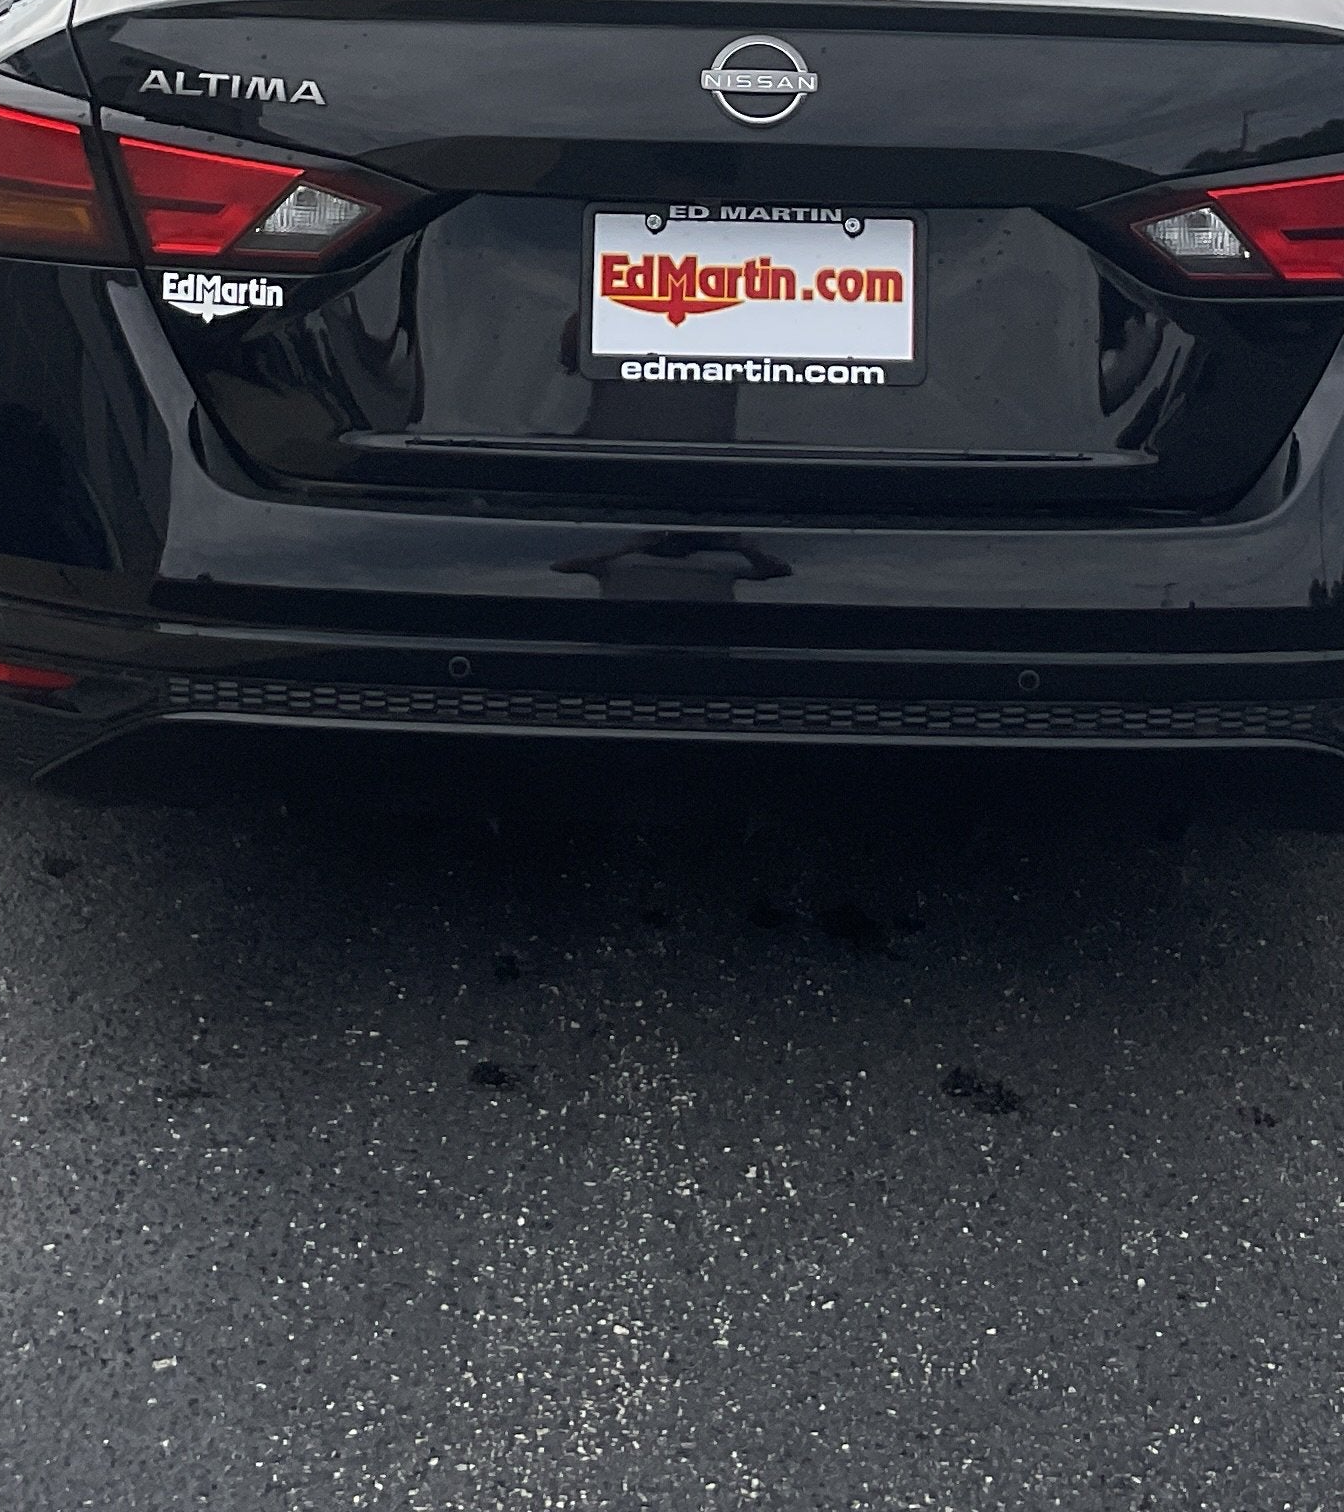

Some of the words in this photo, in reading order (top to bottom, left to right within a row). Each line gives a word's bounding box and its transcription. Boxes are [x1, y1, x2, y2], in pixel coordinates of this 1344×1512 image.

[139, 69, 326, 105] ALTIMA
[704, 74, 815, 90] NISSAN
[669, 205, 710, 219] ED
[720, 206, 842, 222] MARTIN
[162, 272, 284, 307] EdMartin
[621, 356, 885, 384] edmartin.com
